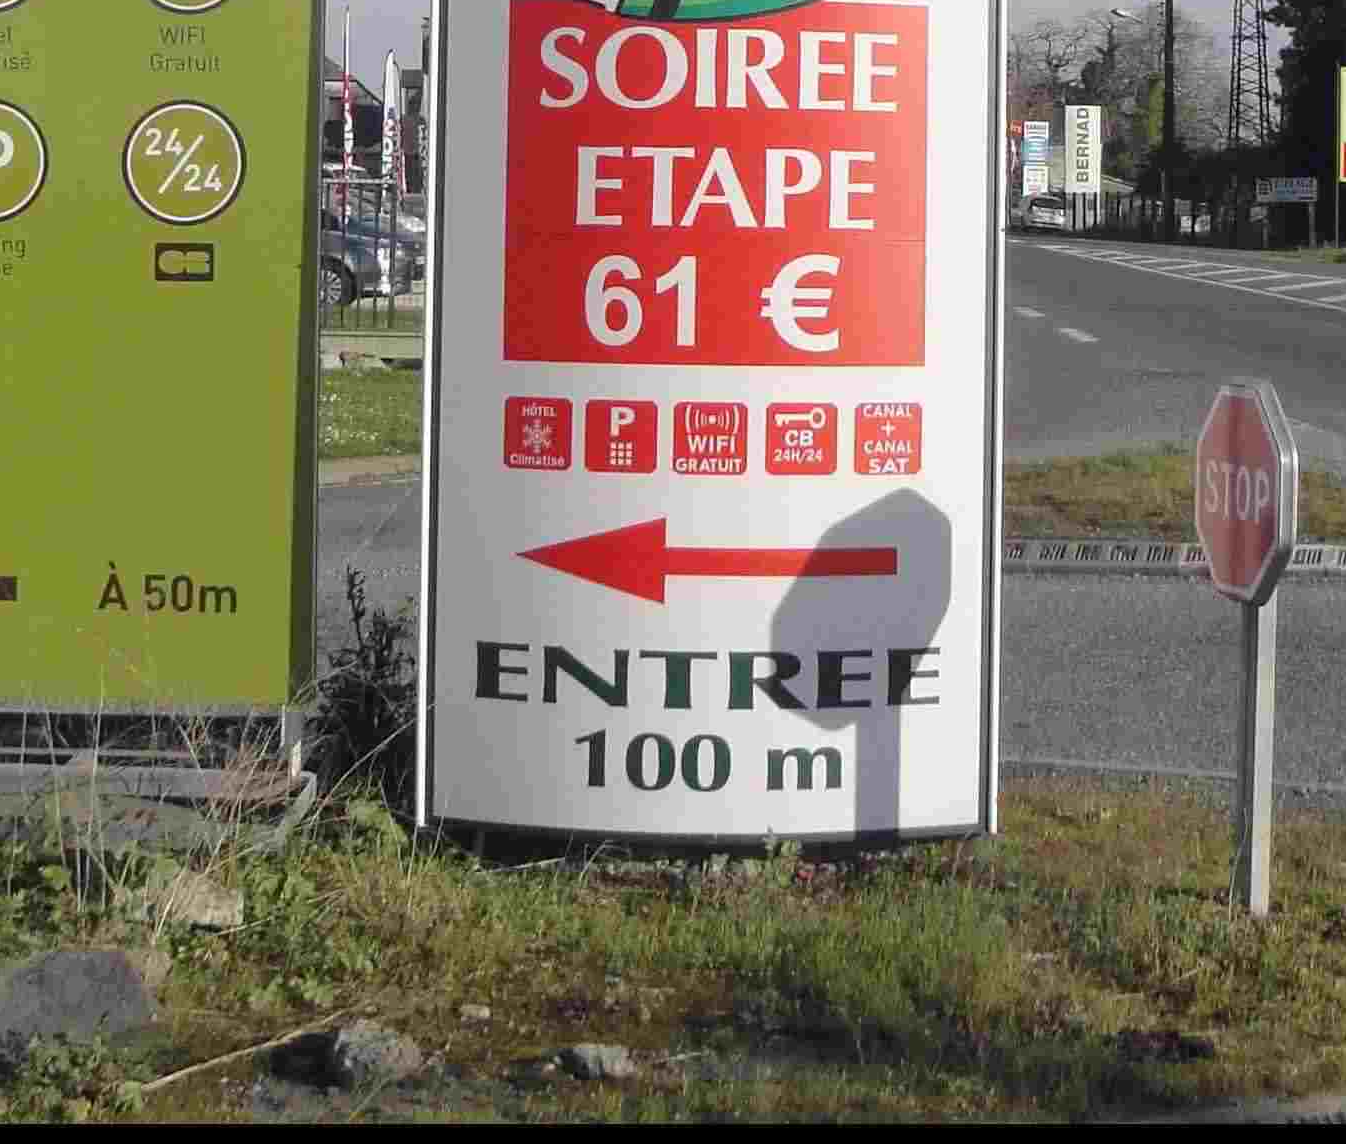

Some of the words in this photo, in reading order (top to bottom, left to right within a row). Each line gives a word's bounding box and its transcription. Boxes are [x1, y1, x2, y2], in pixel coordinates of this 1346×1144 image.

[149, 53, 221, 73] Gratuit
[539, 26, 900, 113] SOIREE
[1076, 107, 1090, 183] BERNAD
[575, 145, 877, 230] ETAPE
[584, 254, 699, 347] 61
[759, 253, 842, 353] €
[610, 406, 636, 438] P
[862, 404, 913, 418] CANAL
[686, 434, 736, 455] WIFI
[784, 429, 814, 447] CB
[862, 440, 913, 455] CANAL
[675, 457, 742, 473] GRATUIT
[773, 448, 823, 464] 24H/24
[868, 457, 911, 473] SAT
[1205, 458, 1269, 525] STOP
[98, 561, 129, 612] À
[143, 574, 238, 613] 50m
[475, 640, 941, 710] ENTREE
[574, 728, 732, 792] 100
[765, 744, 843, 791] m
